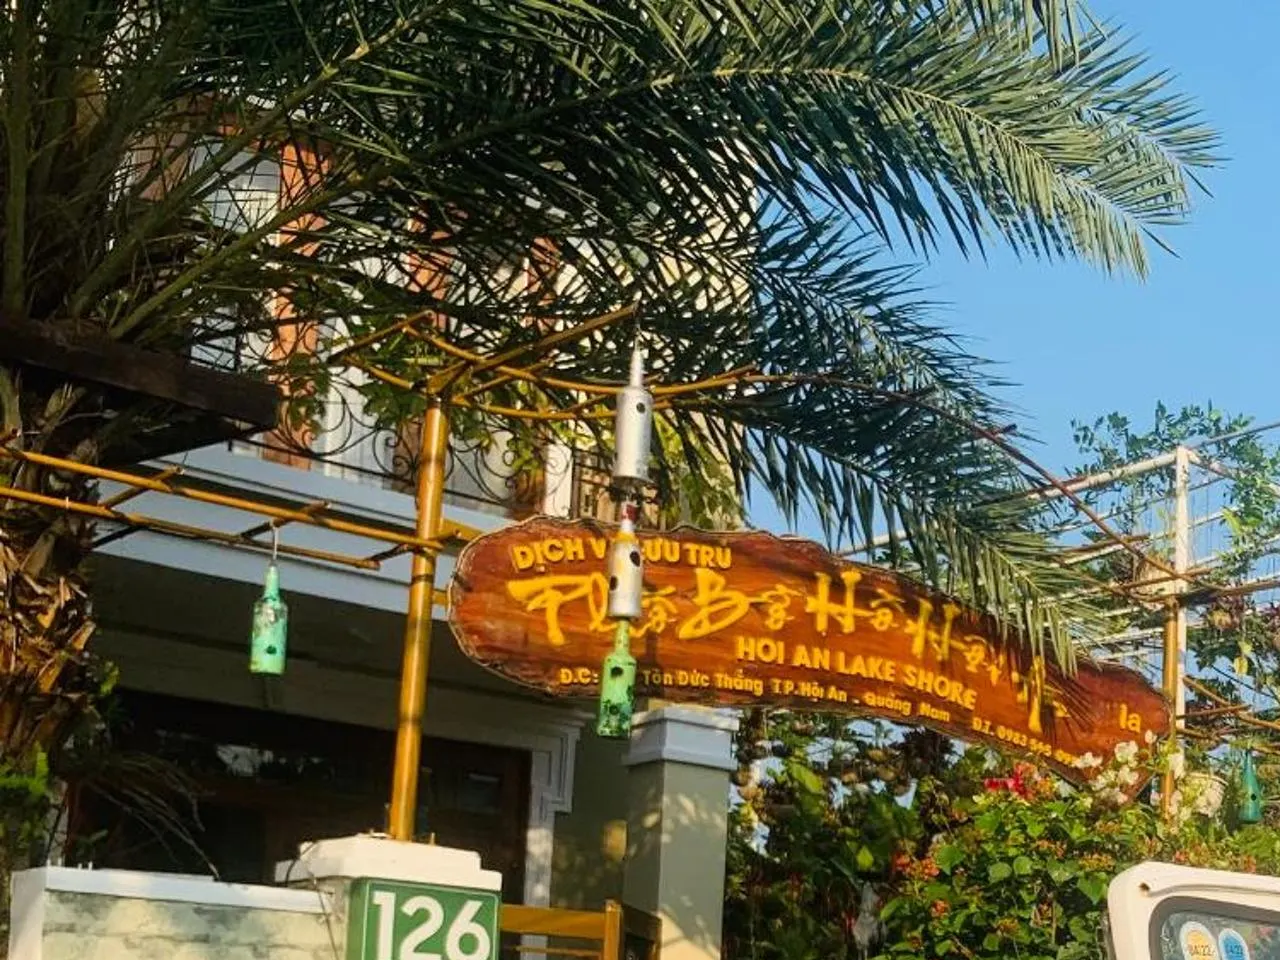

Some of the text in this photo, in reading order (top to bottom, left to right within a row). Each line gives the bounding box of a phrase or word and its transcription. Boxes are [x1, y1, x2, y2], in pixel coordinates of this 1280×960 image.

[508, 538, 586, 574] DỊCH
[640, 536, 681, 563] ƯU
[734, 636, 977, 711] HOI AN LAKE SHORE
